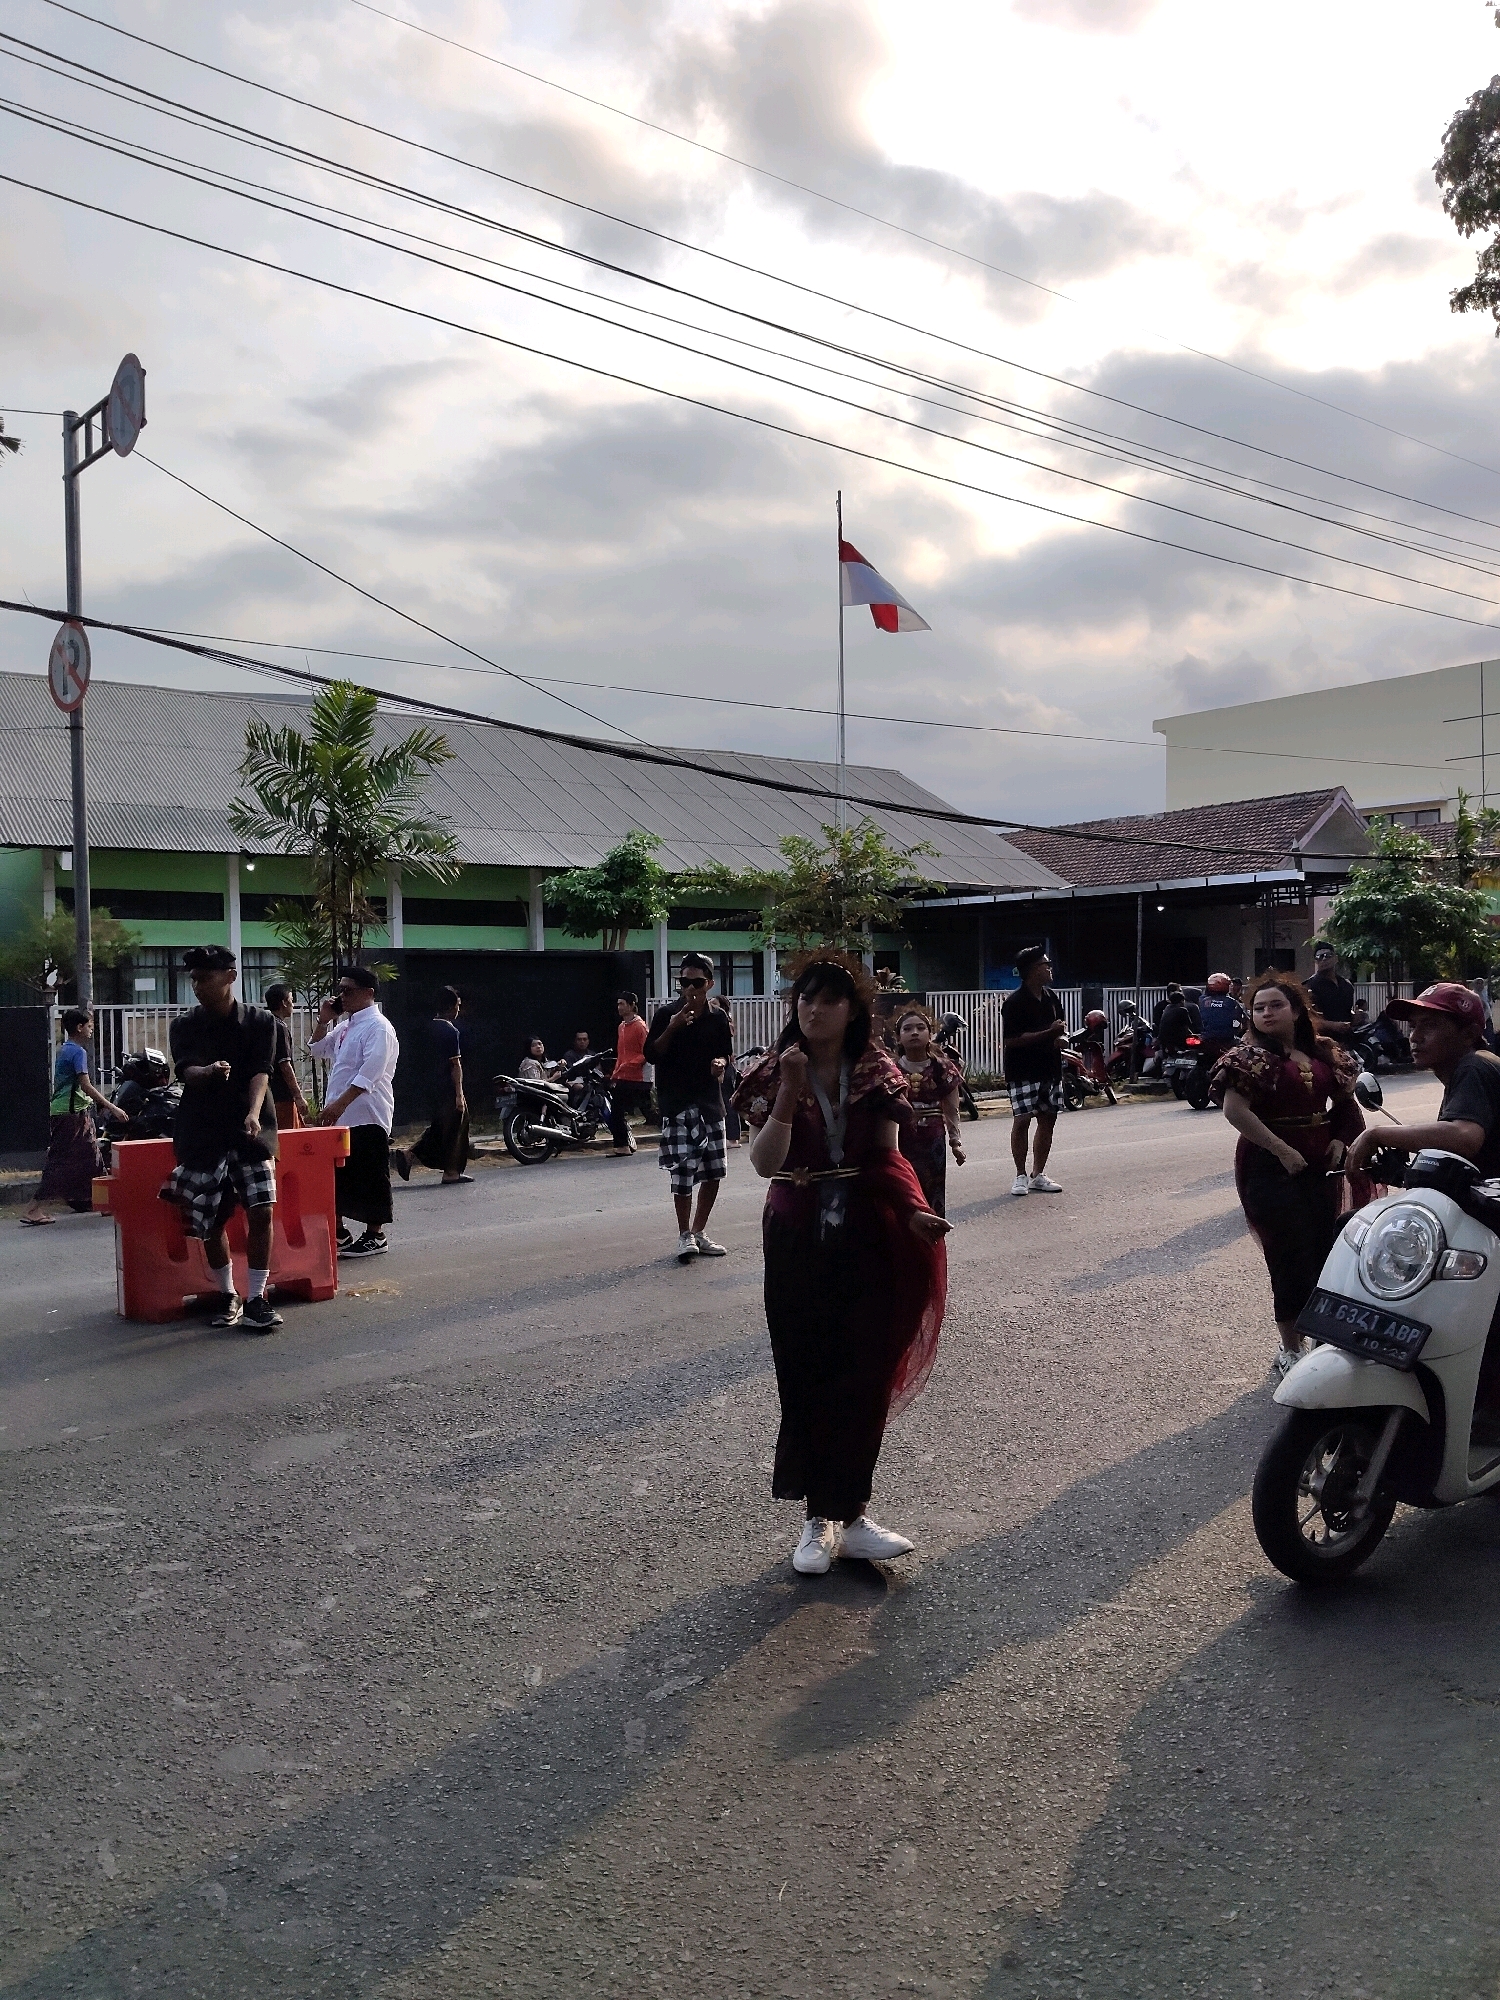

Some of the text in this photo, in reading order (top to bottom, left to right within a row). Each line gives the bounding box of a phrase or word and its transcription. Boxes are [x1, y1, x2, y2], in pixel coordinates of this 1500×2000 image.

[62, 639, 81, 697] P
[1313, 1296, 1421, 1344] N 6341 ABP
